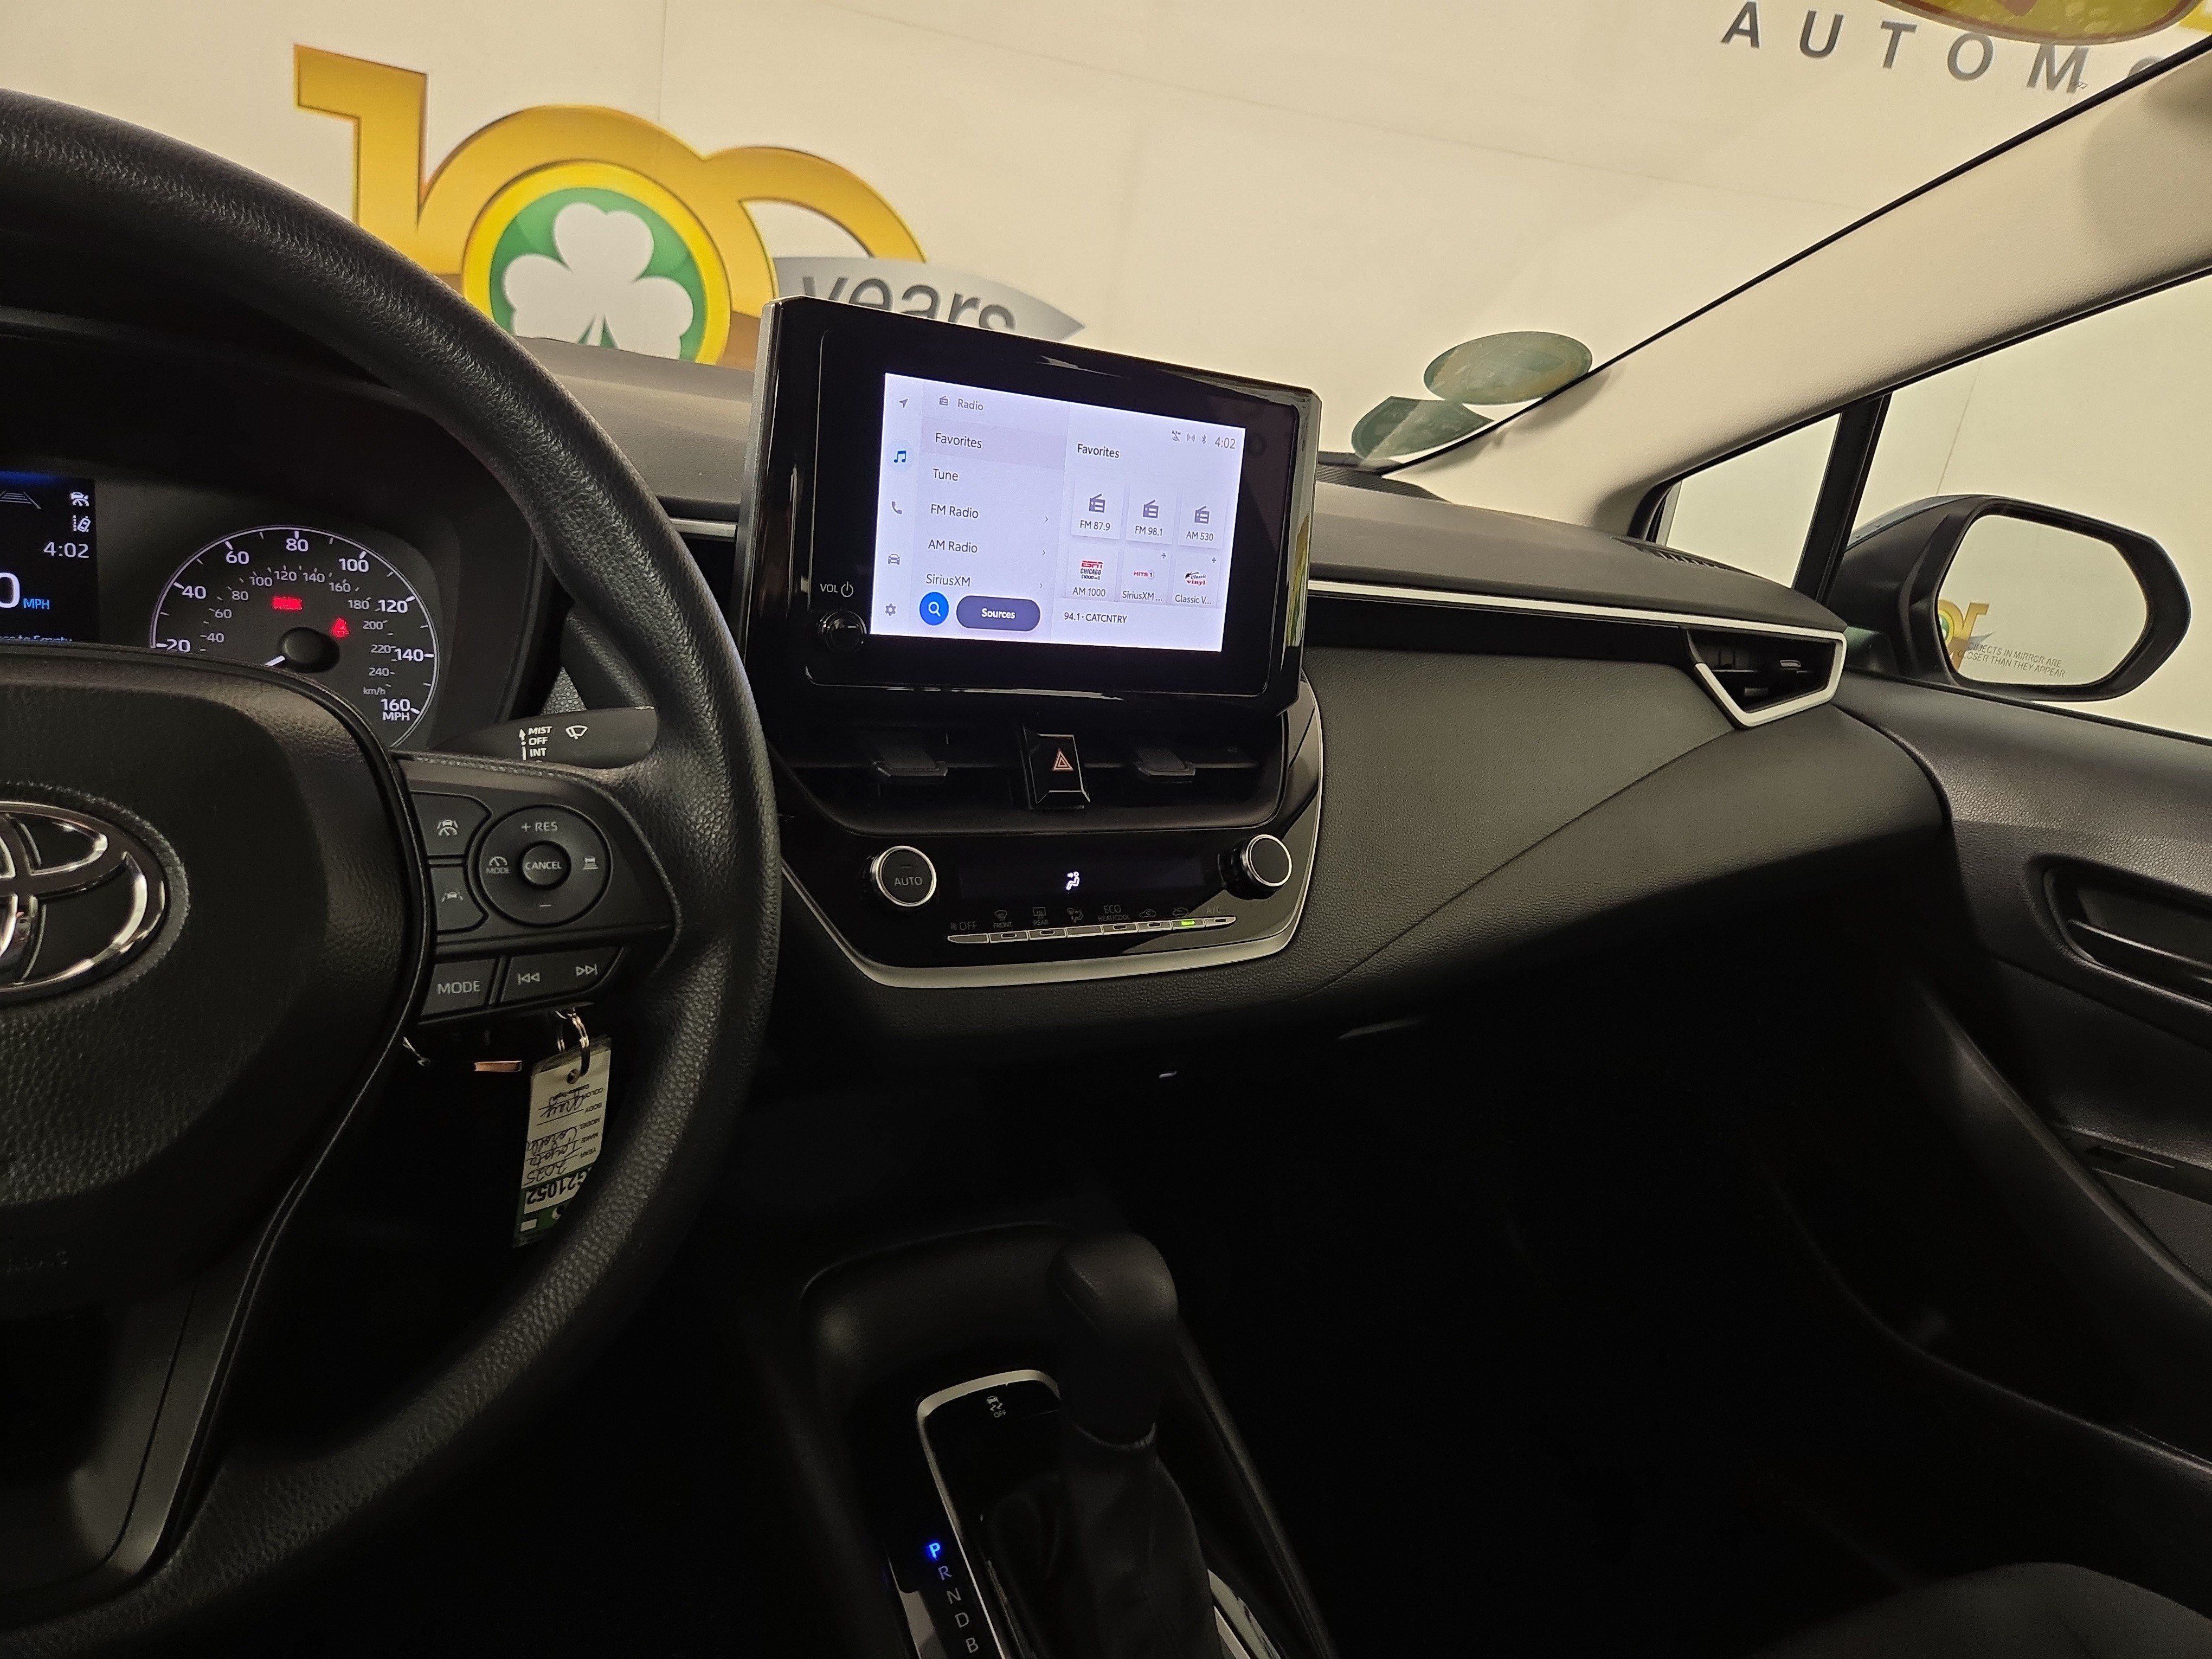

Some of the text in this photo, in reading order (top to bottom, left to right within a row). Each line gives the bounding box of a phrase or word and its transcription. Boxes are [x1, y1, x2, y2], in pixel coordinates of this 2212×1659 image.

[957, 398, 984, 411] Radio
[935, 433, 982, 449] Favorites
[1214, 437, 1236, 450] 4:02
[1077, 443, 1120, 459] Favorites
[933, 469, 959, 482] Tune
[930, 504, 979, 519] FM Radio
[1079, 520, 1111, 532] FM 87.9
[1135, 525, 1163, 537] FM 98.1
[1186, 531, 1214, 542] AM 530
[43, 542, 89, 558] 4:02
[286, 538, 308, 552] 80
[928, 540, 978, 554] AM Radio
[226, 550, 249, 564] 60
[338, 558, 369, 573] 100
[1081, 560, 1103, 569] ESPN
[249, 576, 273, 587] 100
[274, 570, 297, 581] 120
[303, 572, 325, 583] 140
[926, 573, 971, 587] SiriusXM
[0, 573, 50, 610] 0 MPH
[182, 586, 207, 600] 40
[329, 582, 351, 593] 160
[820, 583, 838, 593] VOL
[1072, 587, 1106, 597] AM 1000
[232, 590, 249, 601] 80
[1122, 590, 1154, 601] SiriusXM
[1175, 594, 1200, 603] Classic
[348, 600, 370, 610] 180
[378, 599, 408, 613] 120
[215, 609, 232, 619] 60
[981, 608, 1016, 620] Sources
[362, 620, 384, 630] 200
[207, 633, 225, 643] 40
[166, 639, 190, 652] 20
[371, 644, 391, 654] 220
[394, 648, 424, 662] 140
[1967, 642, 2062, 667] OBJECTS IN MIRROR ARE
[1958, 651, 2066, 678] CLOSER THAN THEY APPEAR
[369, 667, 390, 677] 240
[363, 686, 386, 696] km/h
[380, 698, 410, 711] 160
[382, 712, 410, 721] MPH
[528, 726, 552, 735] MIST
[529, 737, 548, 745] OFF
[530, 748, 548, 757] INT
[535, 822, 558, 832] RES
[525, 861, 562, 870] CANCEL
[894, 877, 923, 887] AUTO
[1206, 906, 1223, 915] A/C
[960, 921, 978, 930] OFF
[437, 981, 480, 994] MODE
[993, 1410, 1007, 1418] OFF
[929, 1542, 941, 1558] P
[938, 1565, 952, 1580] R
[946, 1587, 962, 1604] N
[955, 1612, 970, 1628] D
[965, 1637, 979, 1653] B
